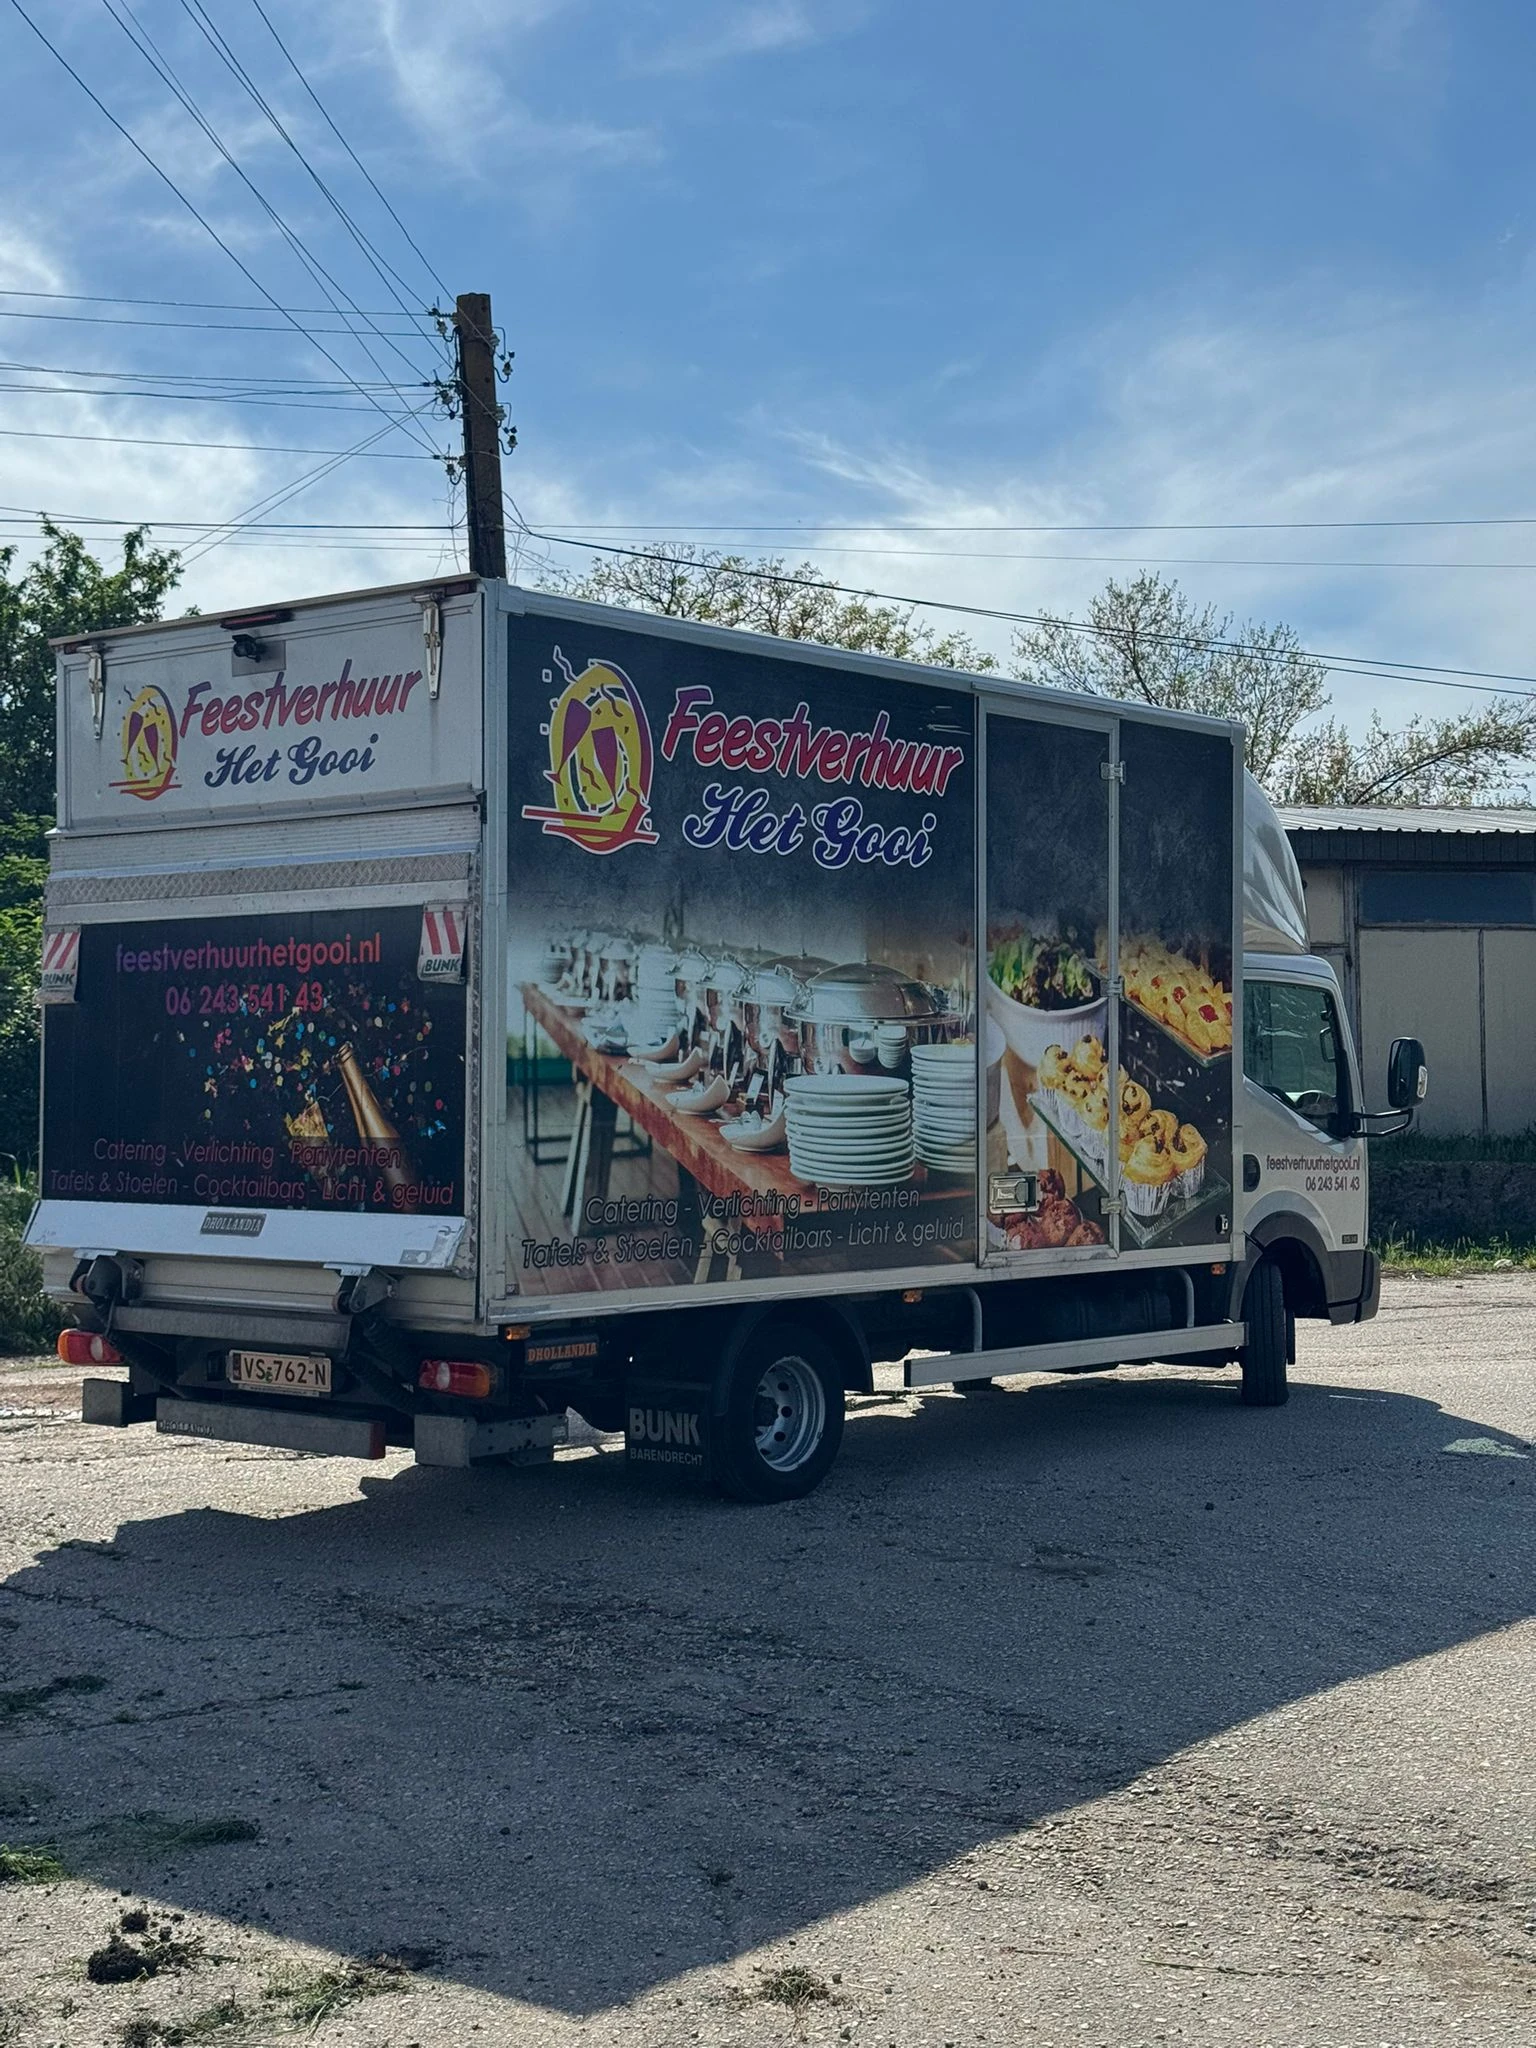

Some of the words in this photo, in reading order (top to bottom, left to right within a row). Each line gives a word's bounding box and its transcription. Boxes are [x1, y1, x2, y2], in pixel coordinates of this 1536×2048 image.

[179, 658, 422, 738] Feestverhuur
[661, 685, 964, 797] Feestverhuur
[204, 743, 282, 788] Het
[288, 733, 379, 785] Gooi
[682, 783, 807, 856] Het
[812, 796, 936, 870] Gooi
[116, 932, 381, 973] feestverhuurhetgooi.nl
[425, 958, 461, 972] BUNK
[165, 987, 191, 1016] 06
[199, 985, 239, 1014] 243
[247, 983, 285, 1012] 541
[295, 981, 323, 1012] 43
[94, 1137, 167, 1168] Catering
[182, 1139, 275, 1169] Verlichting
[291, 1142, 401, 1169] Partytenten
[1266, 1155, 1360, 1173] feestverhuurhetgooi.nl
[49, 1168, 97, 1193] Tafels
[99, 1171, 111, 1193] &
[116, 1169, 178, 1195] Stoelen
[193, 1172, 306, 1200] Cocktailbars
[322, 1175, 368, 1201] Licht
[373, 1179, 386, 1202] &
[392, 1181, 454, 1208] geluid
[1305, 1177, 1316, 1191] 06
[1318, 1176, 1332, 1191] 243
[1334, 1176, 1348, 1191] 541
[1350, 1176, 1360, 1191] 43
[202, 1214, 263, 1233] DHOLLANDIA
[585, 1195, 678, 1226] Catering
[698, 1190, 802, 1220] Verlichting
[816, 1186, 920, 1217] Partytenten
[522, 1236, 586, 1269] Tafels
[594, 1238, 610, 1263] &
[615, 1232, 693, 1263] Stoelen
[710, 1223, 833, 1256] Cocktailbars
[848, 1219, 891, 1247] Licht
[895, 1221, 908, 1243] &
[912, 1215, 965, 1246] geluid
[527, 1342, 597, 1362] DHOLLANDIA
[244, 1357, 326, 1386] VS-762-N
[629, 1408, 700, 1445] BUNK
[630, 1448, 703, 1466] BARENDRECHT
